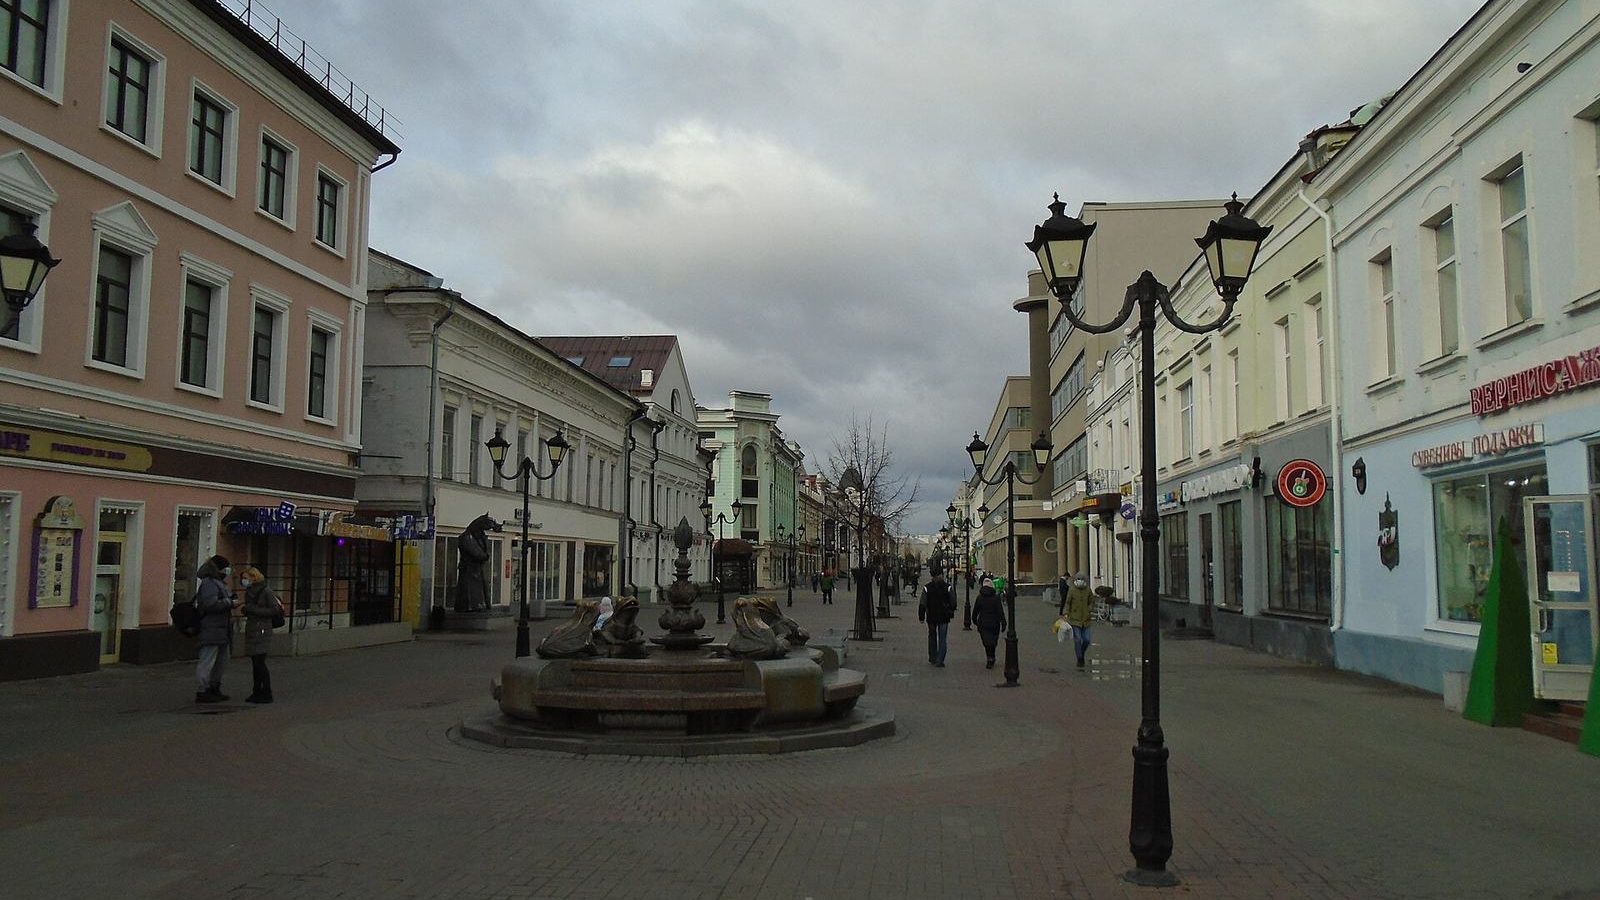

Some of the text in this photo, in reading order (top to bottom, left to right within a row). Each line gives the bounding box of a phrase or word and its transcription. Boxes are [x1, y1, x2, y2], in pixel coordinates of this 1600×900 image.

[1470, 346, 1600, 415] ВЕРНИСАЖ
[1412, 424, 1535, 468] СУВЕНИРЫ ПОДАРКИ
